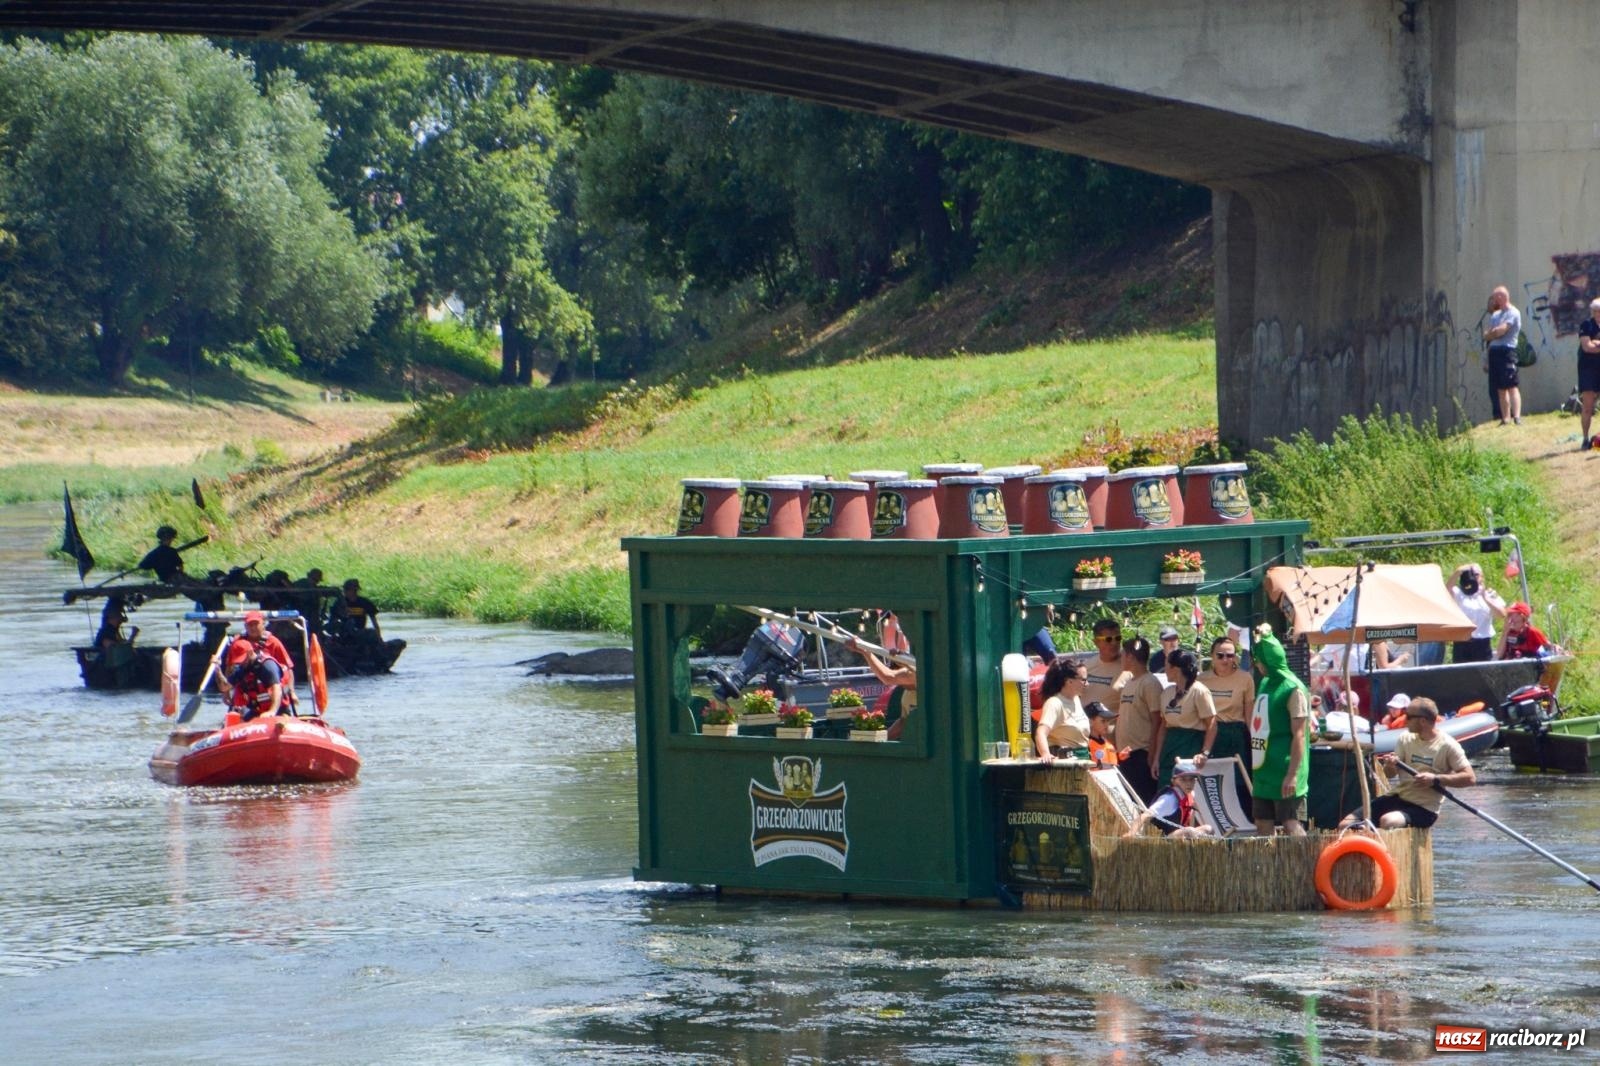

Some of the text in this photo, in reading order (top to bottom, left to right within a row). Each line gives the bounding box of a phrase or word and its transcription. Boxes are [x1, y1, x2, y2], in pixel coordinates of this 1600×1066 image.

[1250, 737, 1266, 750] EER
[756, 806, 843, 832] GRZEGORZOWICKIE
[1007, 811, 1081, 830] GRZEGORZOWICKIE
